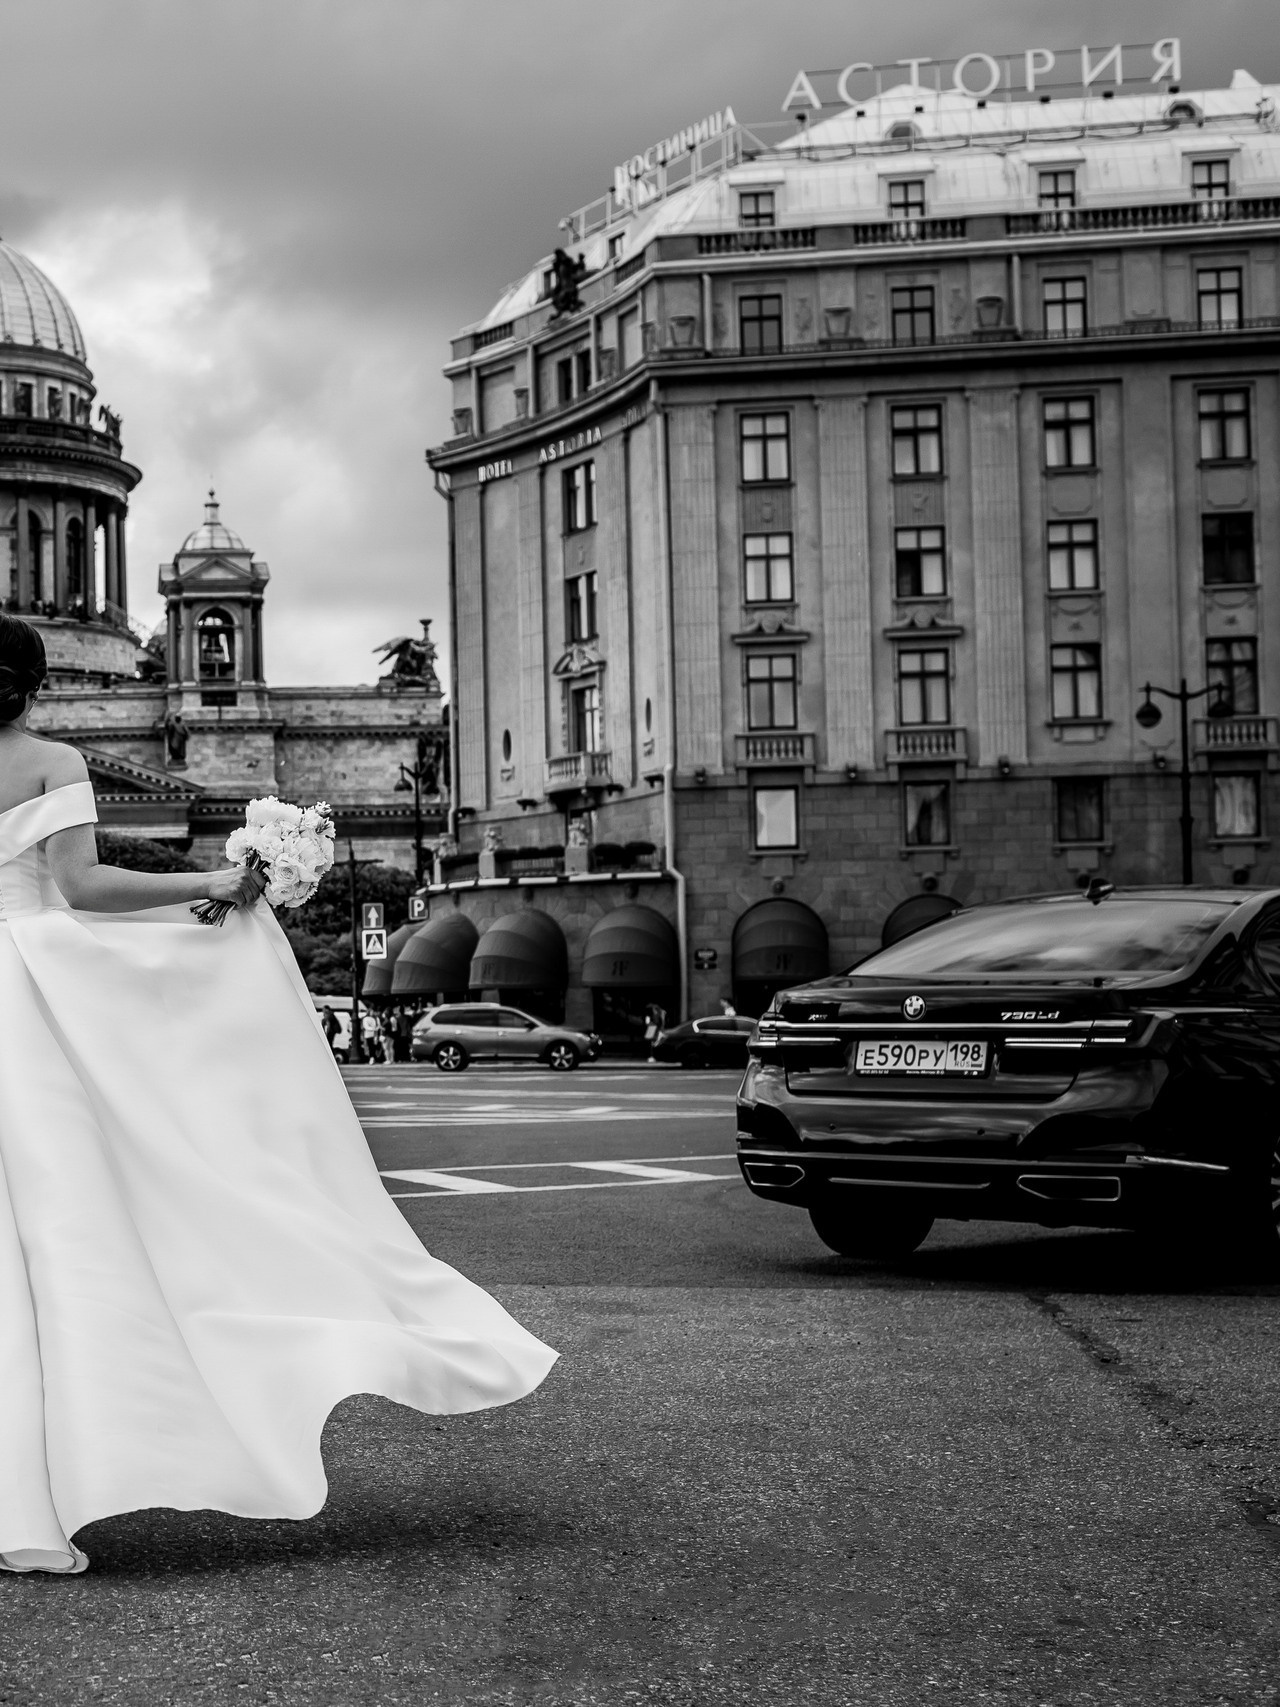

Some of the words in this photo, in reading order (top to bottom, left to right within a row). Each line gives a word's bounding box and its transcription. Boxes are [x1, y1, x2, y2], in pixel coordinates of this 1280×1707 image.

[781, 37, 1182, 112] АСТОРИЯ
[478, 459, 513, 483] HOTEL
[538, 426, 602, 463] ASTORIA
[413, 899, 425, 917] P
[950, 1043, 982, 1062] 198
